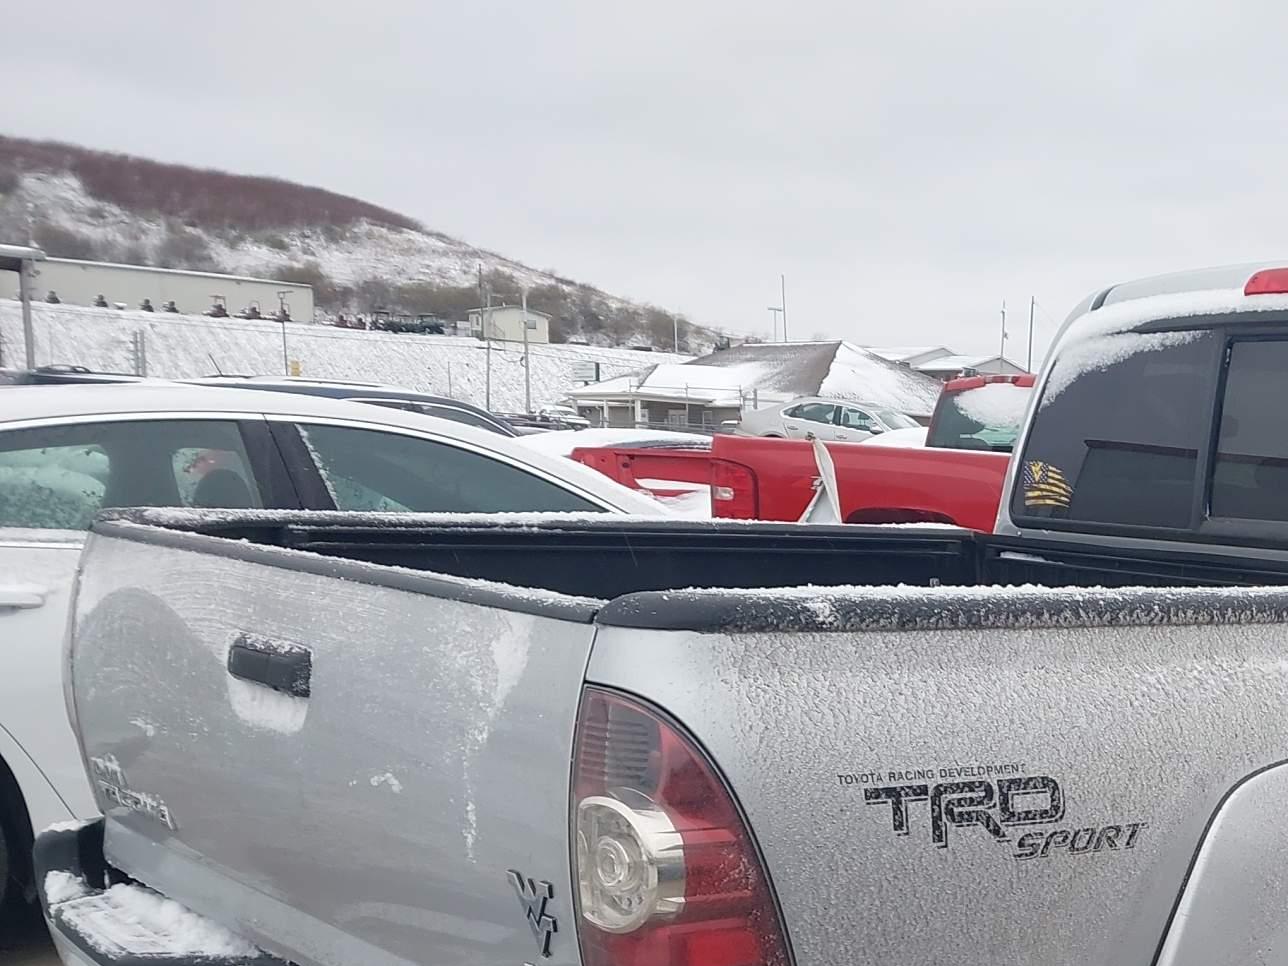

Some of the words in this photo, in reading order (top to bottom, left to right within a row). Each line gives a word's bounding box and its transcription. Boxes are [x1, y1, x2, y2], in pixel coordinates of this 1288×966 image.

[837, 774, 884, 785] TOYOTA
[888, 769, 935, 782] RACING
[938, 762, 1027, 777] DEVELOPMENT
[863, 775, 1066, 850] TRD
[1012, 823, 1149, 860] SPORT
